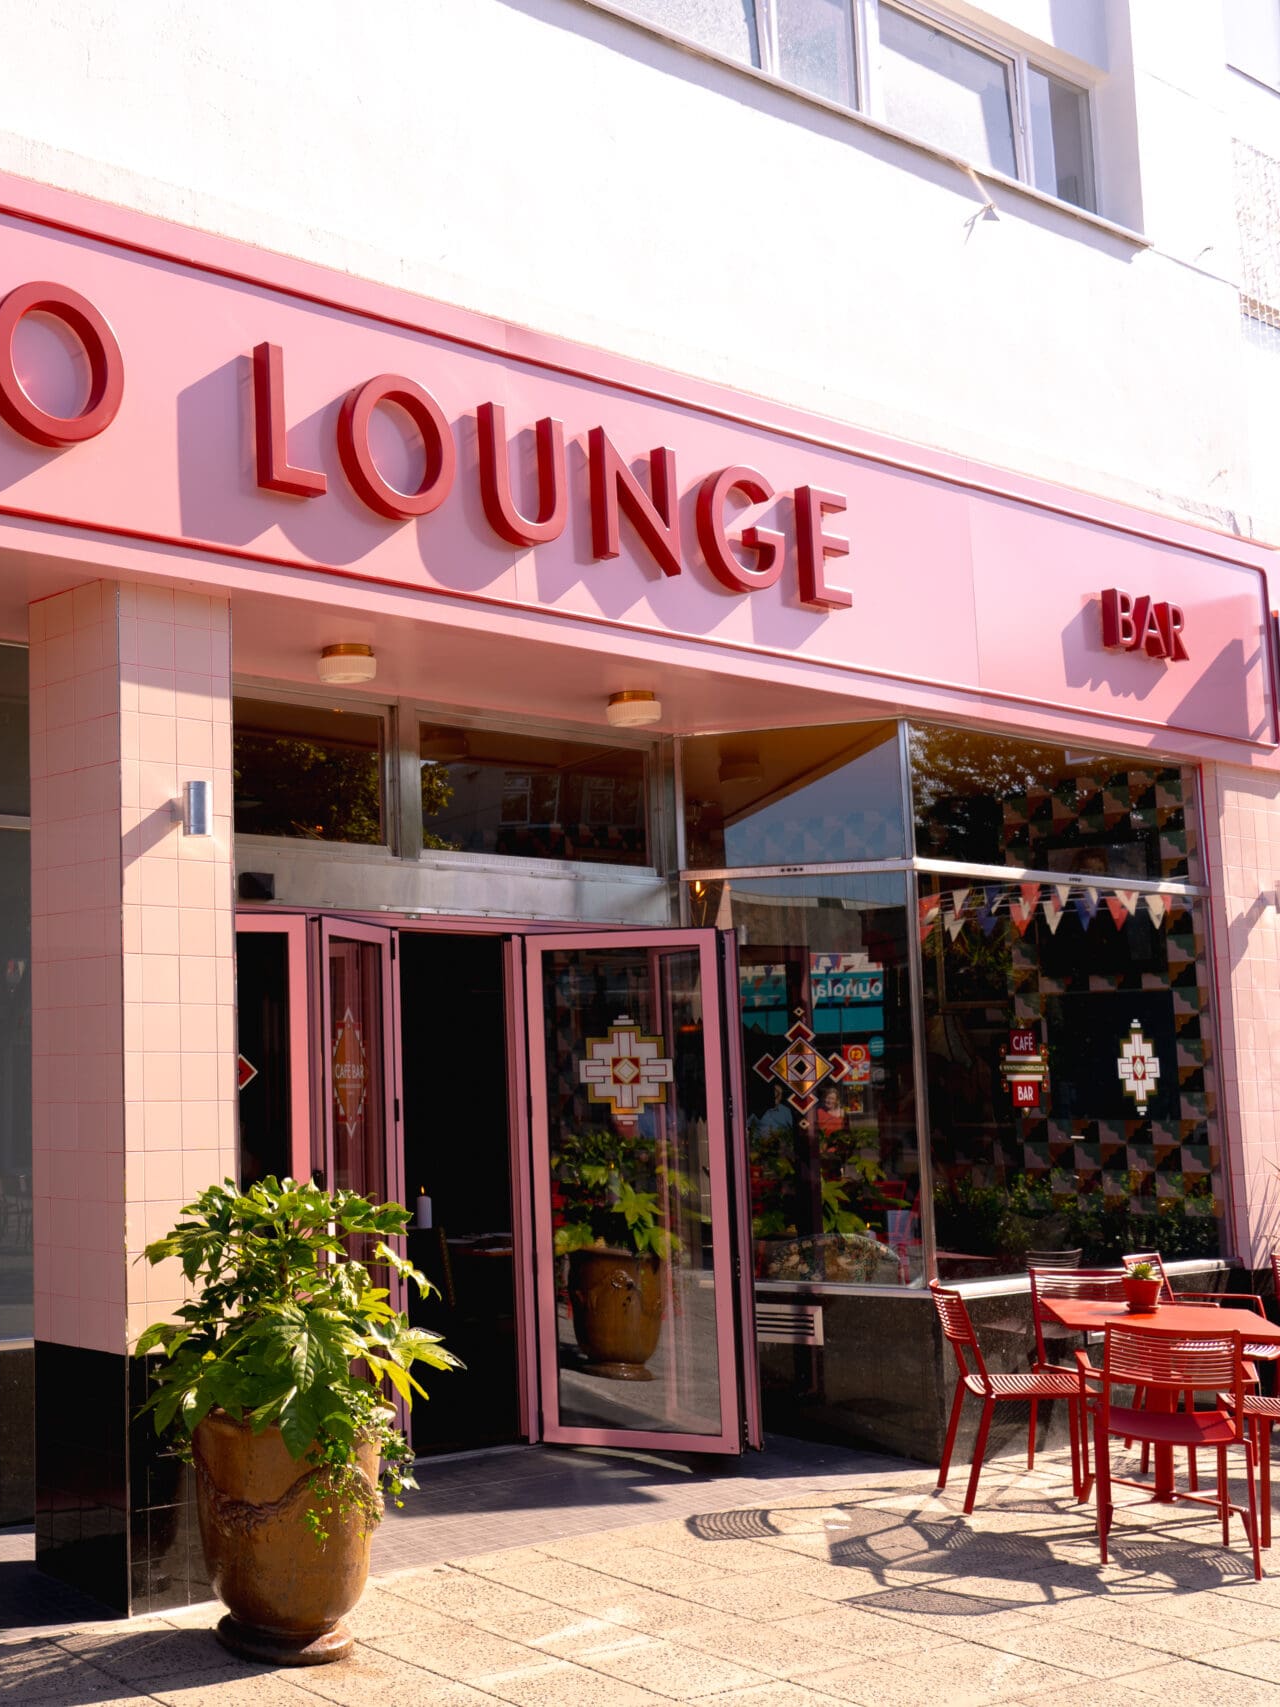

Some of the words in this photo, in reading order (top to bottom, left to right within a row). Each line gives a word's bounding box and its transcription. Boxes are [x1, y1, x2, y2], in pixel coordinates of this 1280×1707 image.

[252, 341, 853, 609] LOUNGE
[1101, 588, 1191, 662] BAR
[1012, 1032, 1033, 1051] CAFÉ
[351, 1063, 364, 1079] BAR
[1017, 1086, 1033, 1101] BAR
